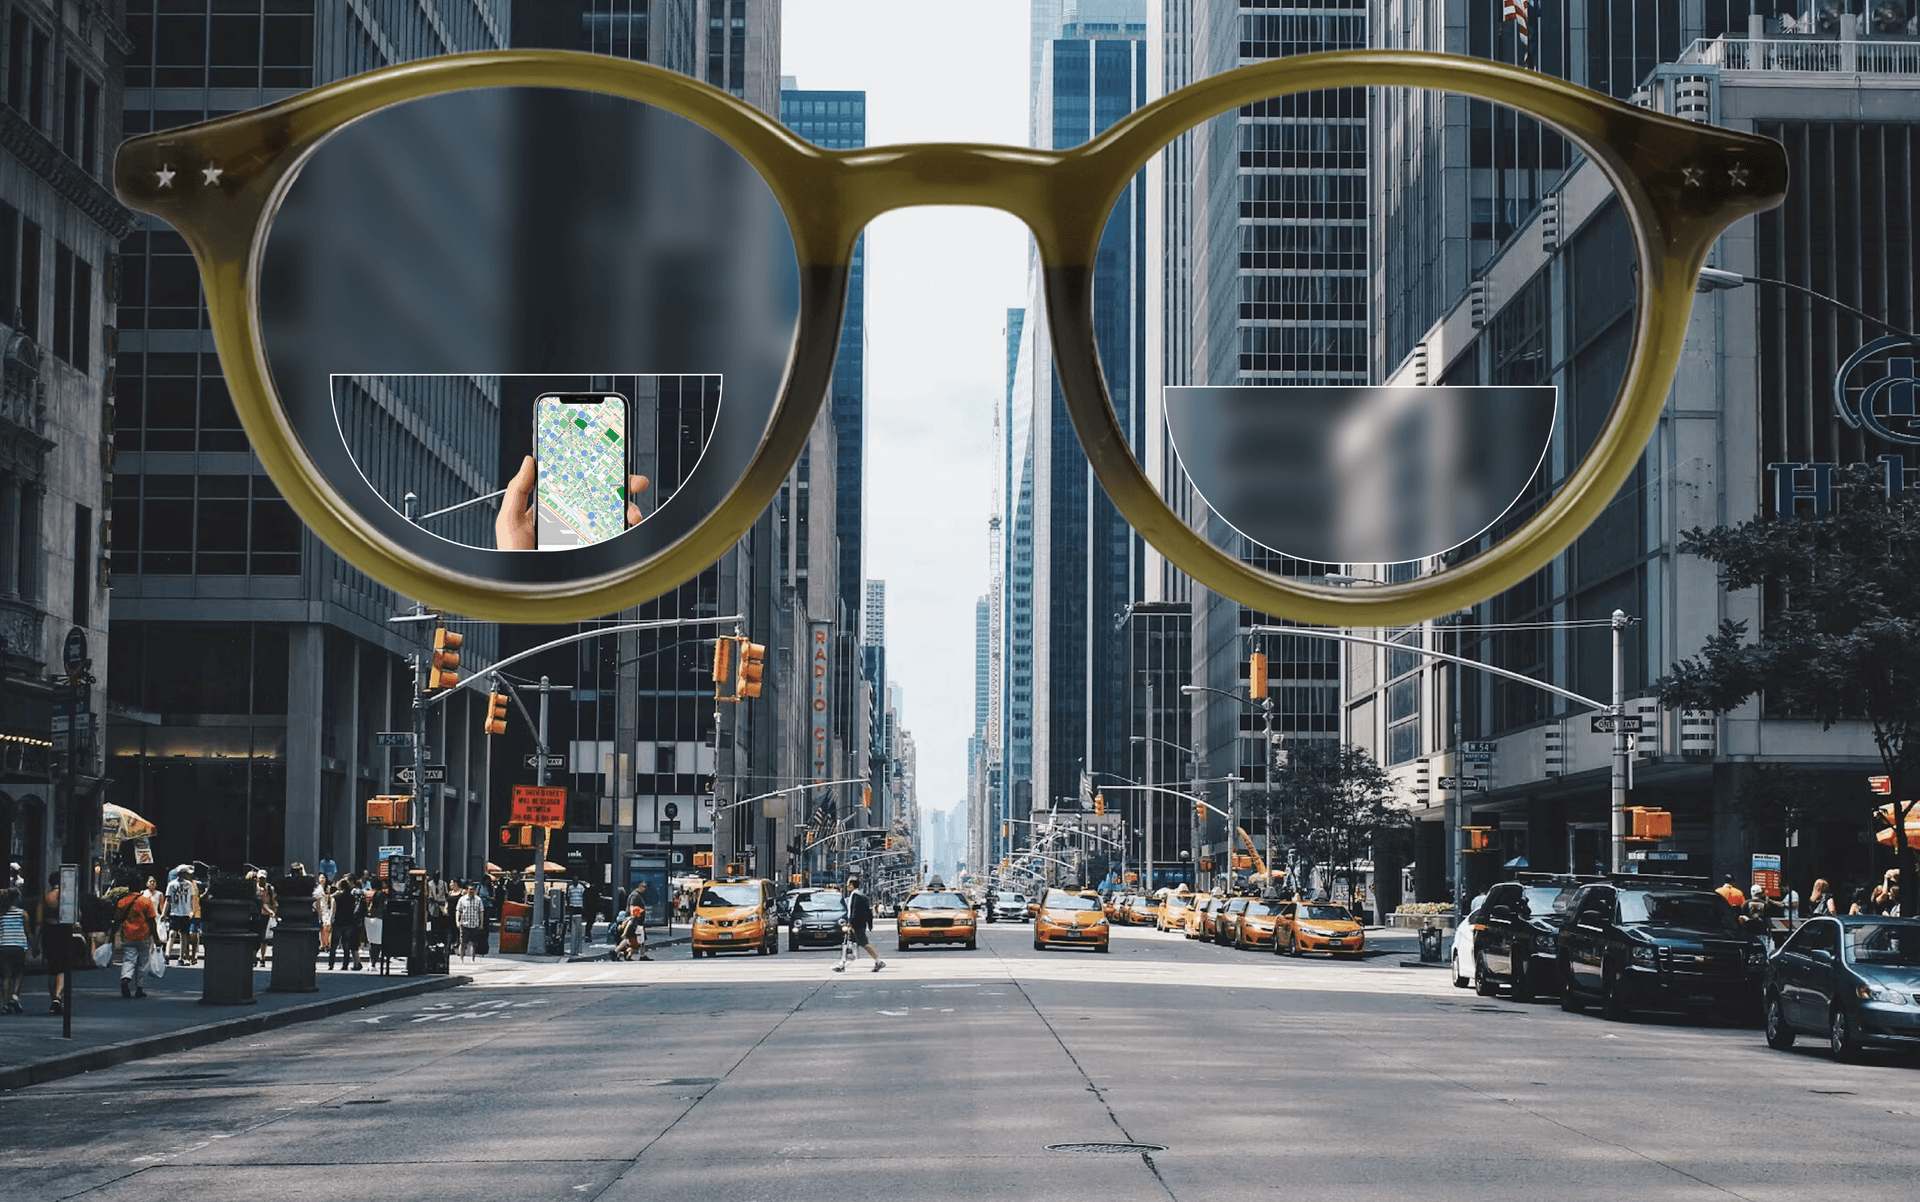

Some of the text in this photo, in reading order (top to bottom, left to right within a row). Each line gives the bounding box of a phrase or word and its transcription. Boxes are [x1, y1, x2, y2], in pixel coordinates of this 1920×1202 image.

[814, 630, 827, 792] RADIO CITY
[378, 734, 385, 745] W
[1480, 743, 1489, 751] 54
